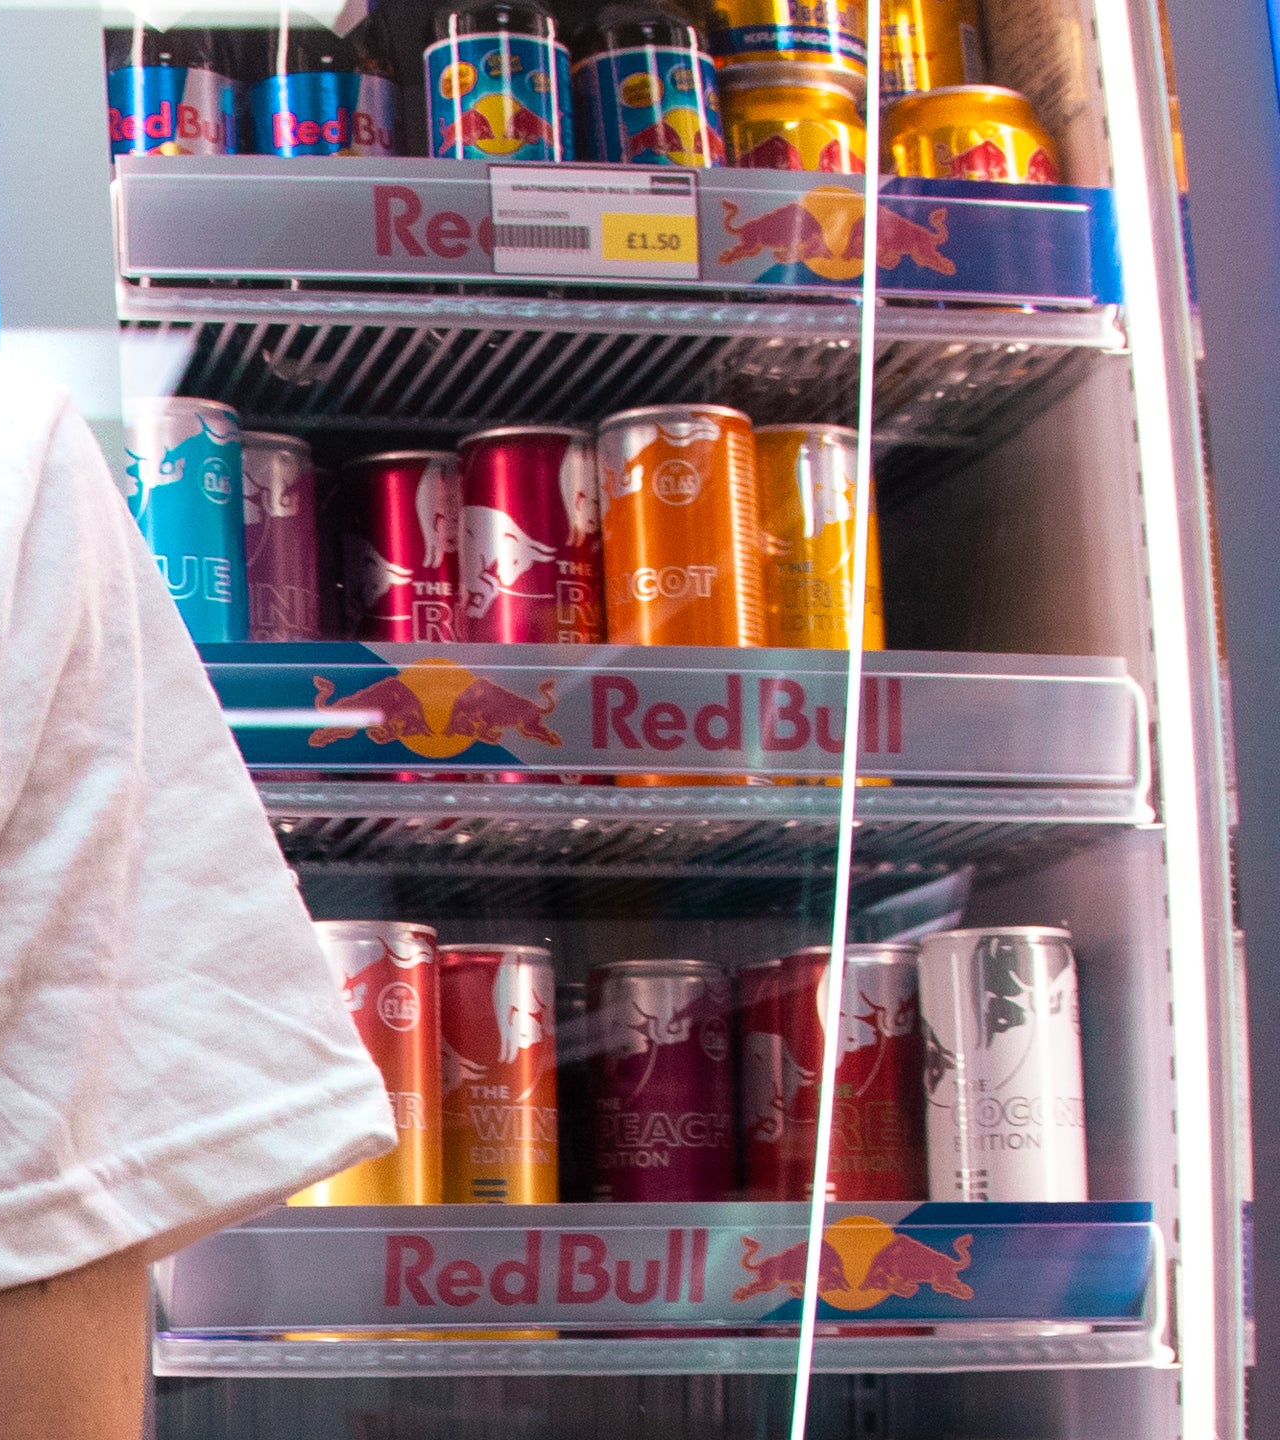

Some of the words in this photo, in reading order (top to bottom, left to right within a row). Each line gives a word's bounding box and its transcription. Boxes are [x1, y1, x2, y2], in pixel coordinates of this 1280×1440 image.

[272, 111, 348, 148] Red
[626, 232, 680, 251] £1.50
[413, 580, 454, 597] THE
[591, 674, 744, 753] Red
[758, 675, 903, 754] Bull
[470, 1085, 510, 1100] THE
[383, 1229, 542, 1307] Red
[556, 1228, 709, 1306] Bull
